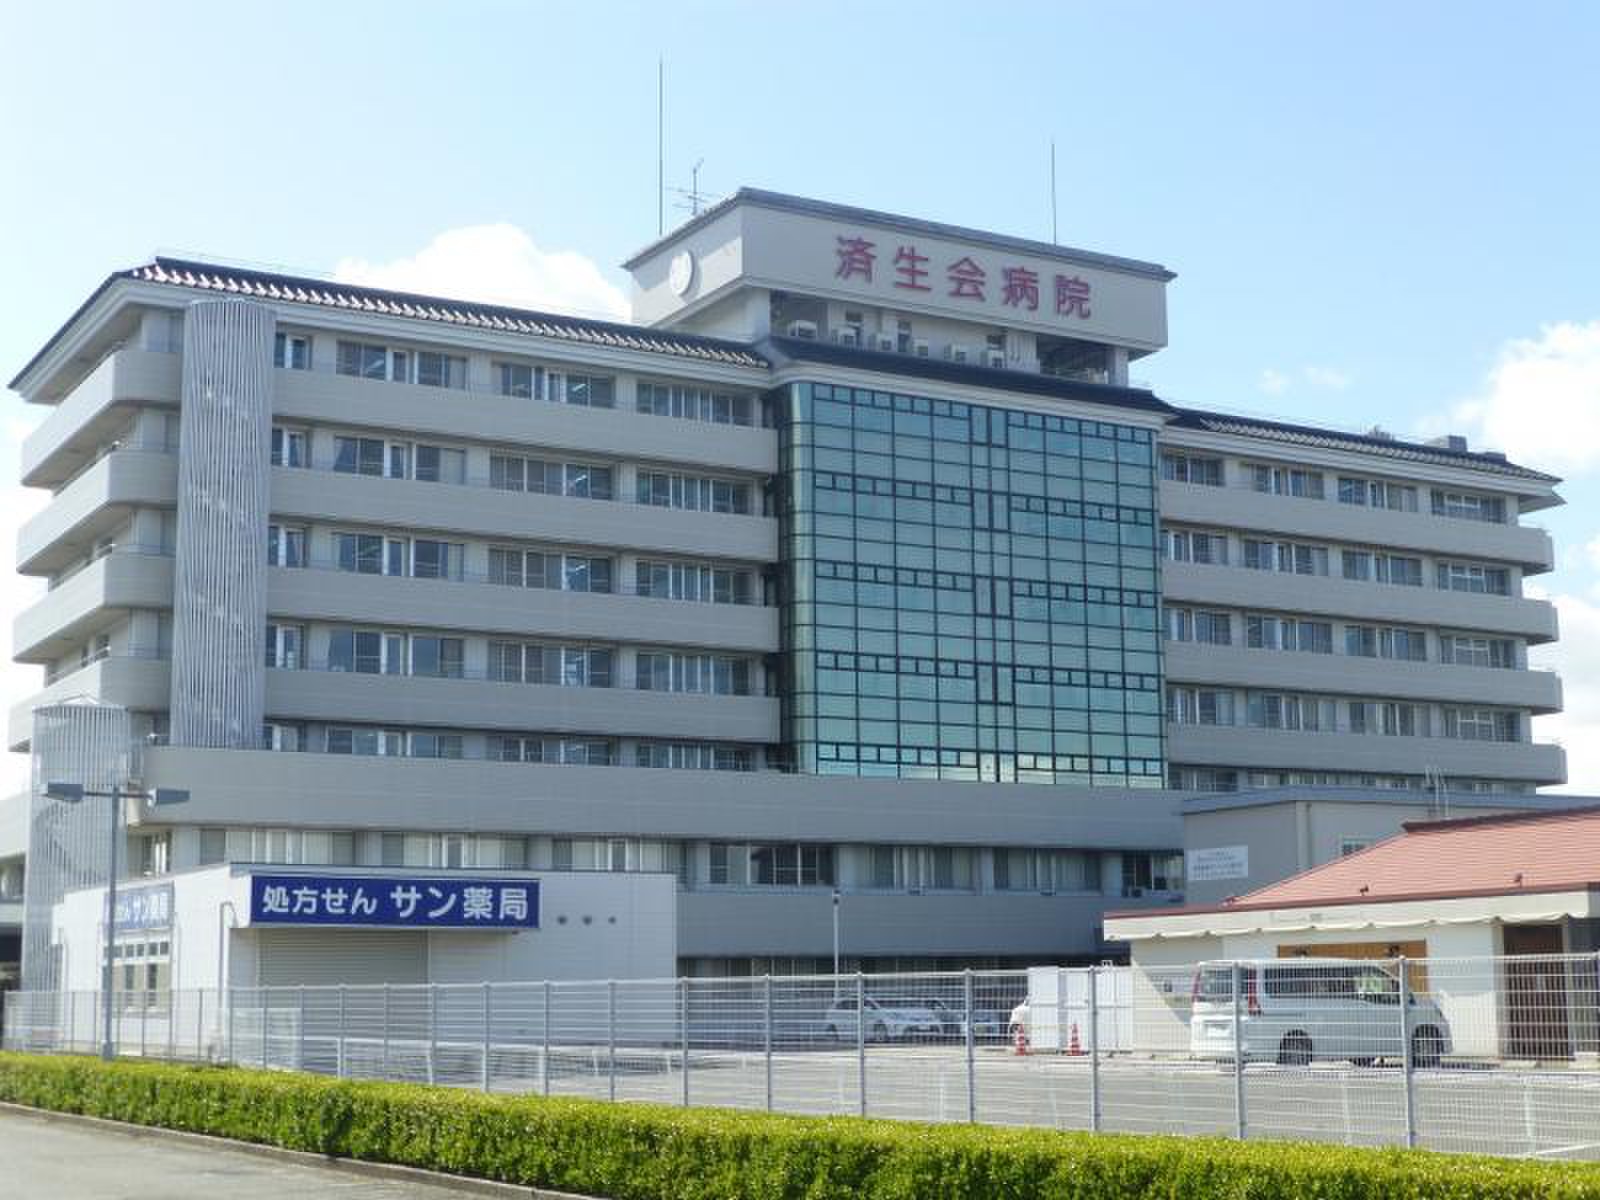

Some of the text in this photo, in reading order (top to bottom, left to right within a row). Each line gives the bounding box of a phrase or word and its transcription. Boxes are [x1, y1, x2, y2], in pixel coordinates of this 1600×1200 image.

[835, 235, 1092, 319] 済生会病院
[262, 885, 528, 919] 処方せん サン薬局
